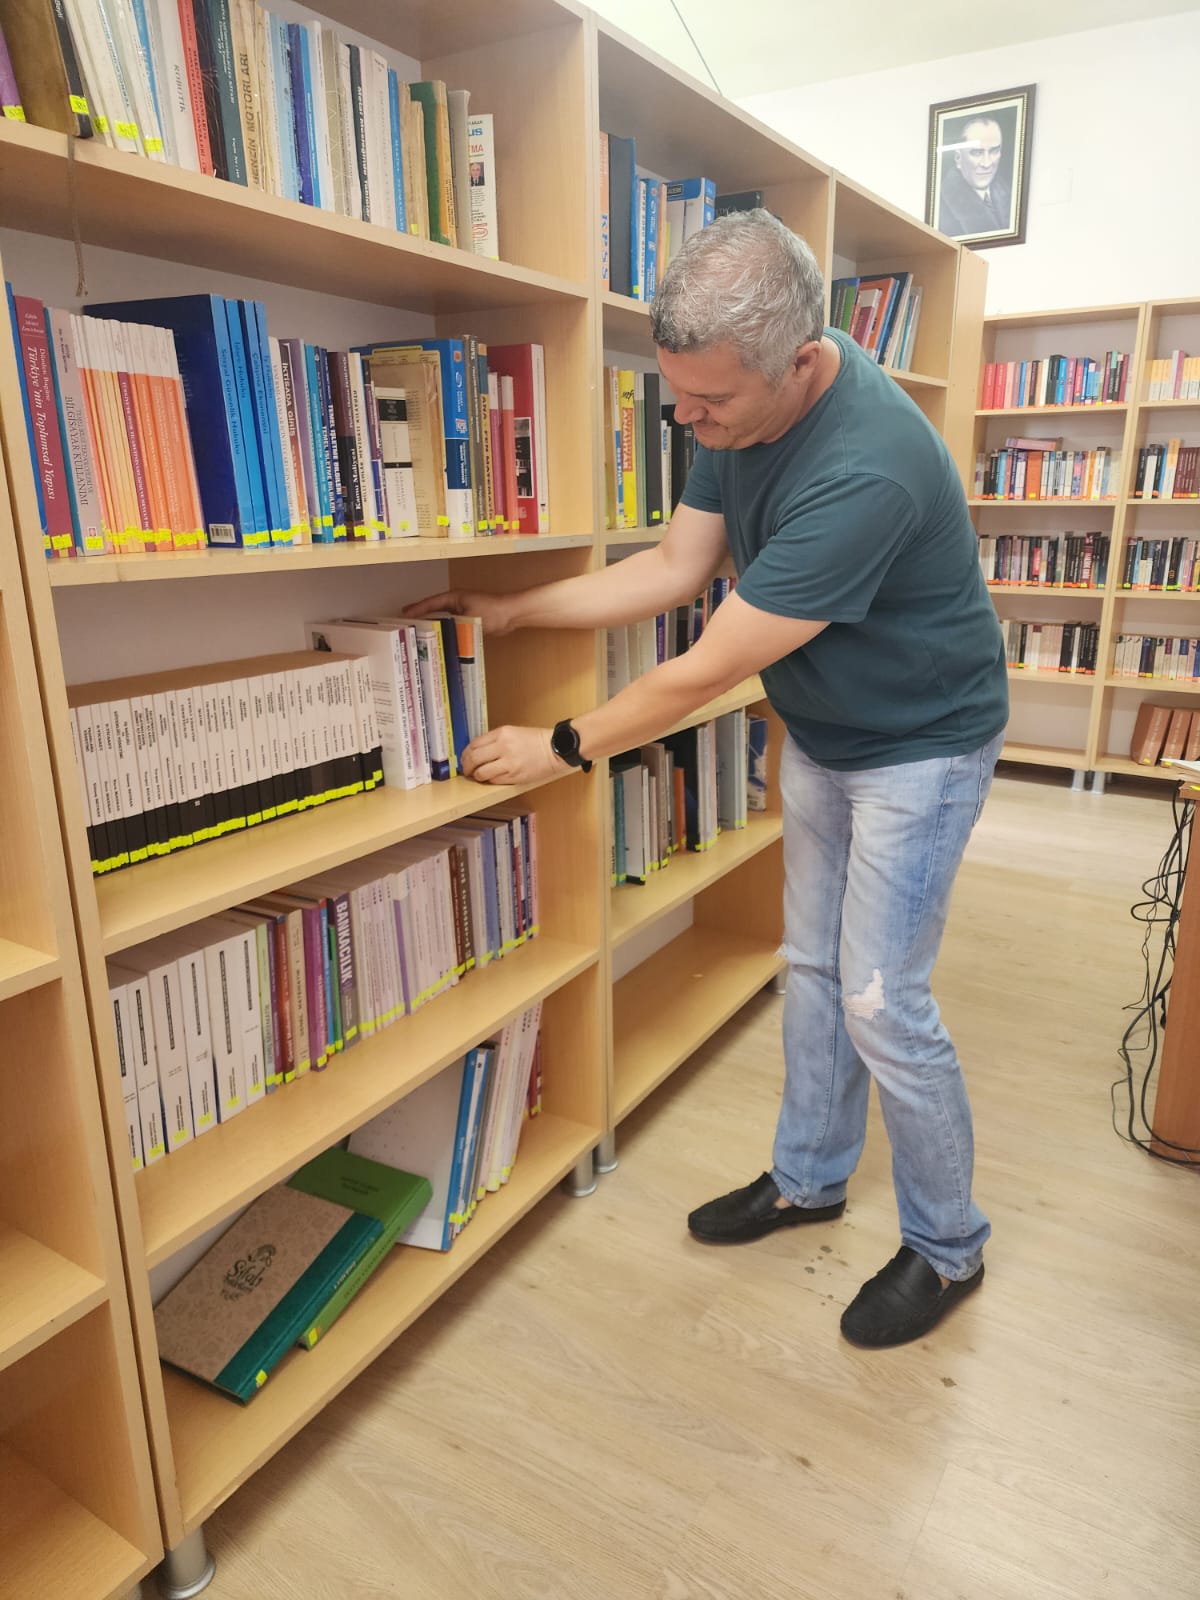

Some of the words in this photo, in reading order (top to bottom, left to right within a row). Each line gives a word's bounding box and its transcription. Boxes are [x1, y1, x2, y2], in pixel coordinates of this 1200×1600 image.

[281, 362, 292, 407] İKTİSADA
[327, 403, 335, 428] TEMEL
[36, 411, 52, 466] Toplumsal
[44, 468, 56, 500] Yapısı
[64, 395, 79, 450] BİLGİSAYAR
[72, 451, 88, 506] KULLANIMI
[336, 900, 352, 983] BANKACILIK
